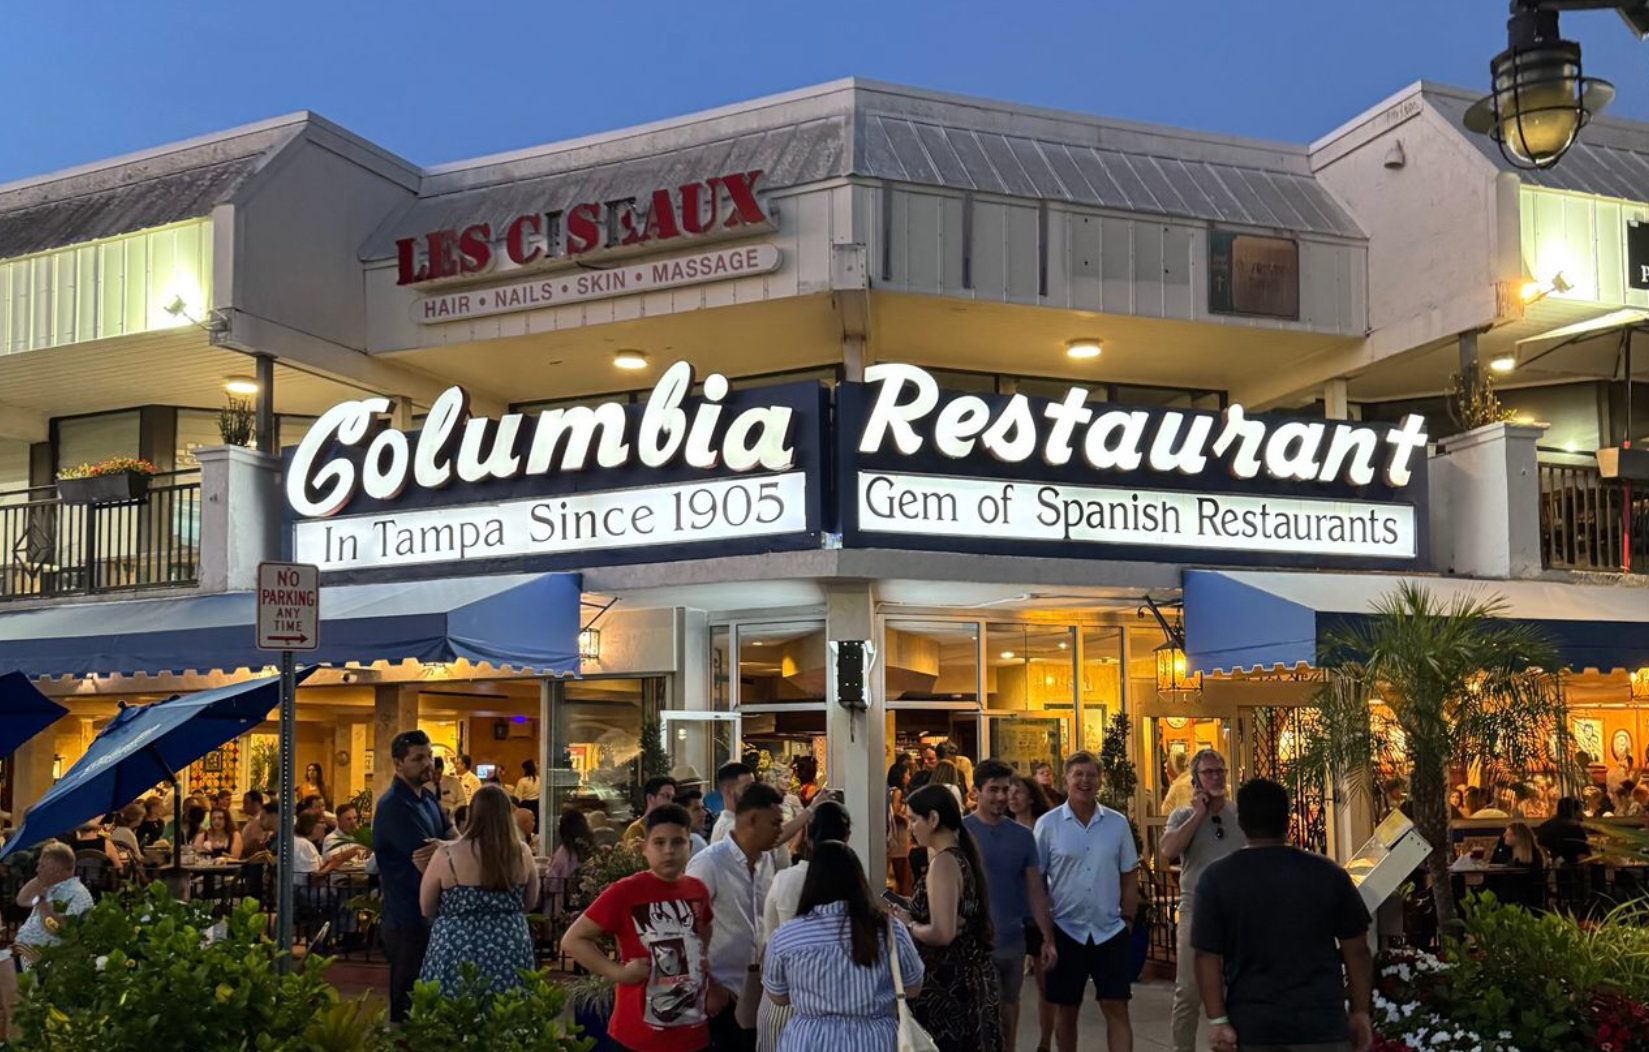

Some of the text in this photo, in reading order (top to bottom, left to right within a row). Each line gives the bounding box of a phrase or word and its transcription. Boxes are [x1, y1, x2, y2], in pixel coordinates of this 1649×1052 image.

[395, 170, 767, 285] LES CISEAUX
[423, 248, 760, 318] HAIR NAILS SKIN MASSAGE
[286, 360, 795, 518] Columbia
[858, 362, 1428, 487] Restaurant
[323, 482, 786, 564] In Tampa Since 1905
[864, 476, 1399, 546] Gem of Spanish Restaurants
[262, 588, 314, 607] PARKING
[276, 607, 300, 619] ANY
[277, 570, 300, 587] NO
[273, 620, 302, 632] TIME
